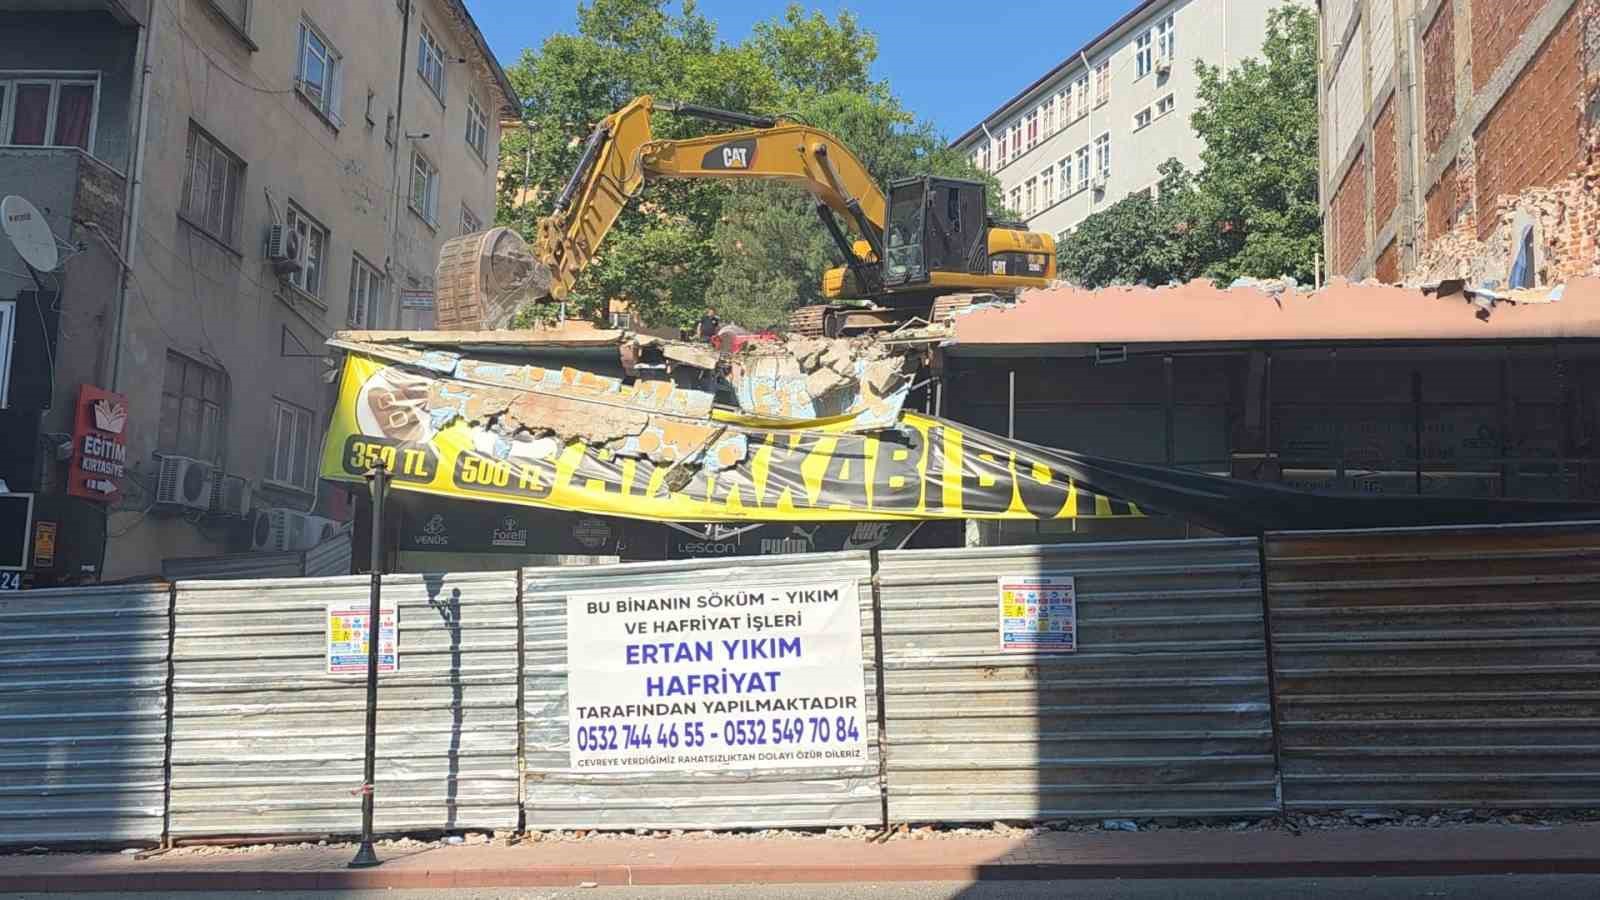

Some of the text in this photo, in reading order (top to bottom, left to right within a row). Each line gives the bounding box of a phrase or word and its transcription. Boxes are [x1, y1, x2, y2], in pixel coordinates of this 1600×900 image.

[723, 147, 747, 168] CAT
[351, 442, 429, 476] 350 TL
[461, 456, 546, 491] 500 TL
[587, 601, 610, 615] BU
[616, 596, 691, 613] BİNANIN
[697, 592, 765, 609] SÖKÜM
[786, 589, 839, 604] YIKIM
[624, 611, 802, 635] VE HAFRİYAT İŞLERİ
[625, 637, 802, 665] ERTAN YIKIM
[646, 668, 782, 698] HAFRİYAT
[576, 695, 857, 719] TARAFINDAN YAPILMAKTADIR
[576, 724, 619, 752] 0532
[621, 723, 653, 750] 744
[656, 722, 680, 749] 46
[684, 721, 705, 748] 55
[723, 718, 767, 747] 0532
[771, 717, 805, 745] 549
[808, 716, 831, 743] 70
[835, 715, 860, 743] 84
[577, 749, 861, 768] ÇEVREYE VERDİĞİMİZ RAHATSIZLIKTAN DOLAYI ÖZÜR DİLERİZ
